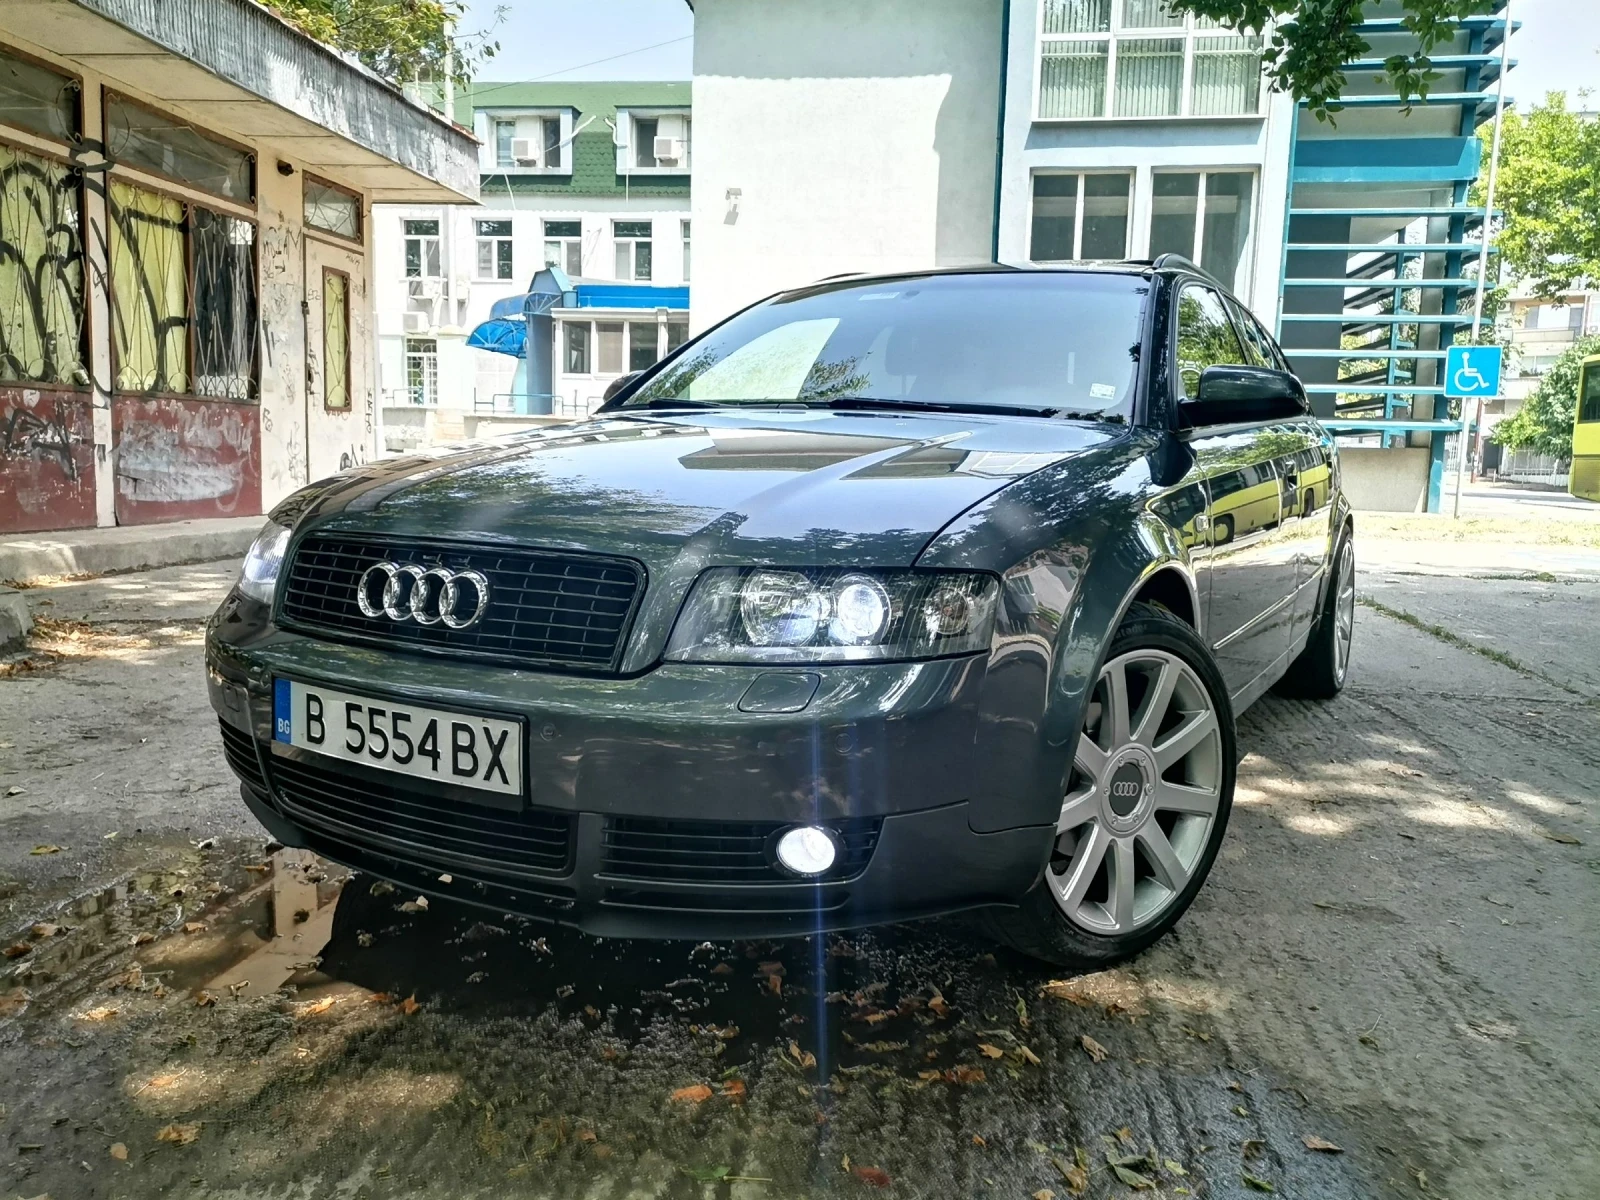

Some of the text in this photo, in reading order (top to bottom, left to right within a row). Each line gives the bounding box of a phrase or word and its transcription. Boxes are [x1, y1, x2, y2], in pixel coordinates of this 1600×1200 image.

[1114, 623, 1148, 639] atador
[277, 717, 290, 735] BG
[305, 692, 327, 745] B
